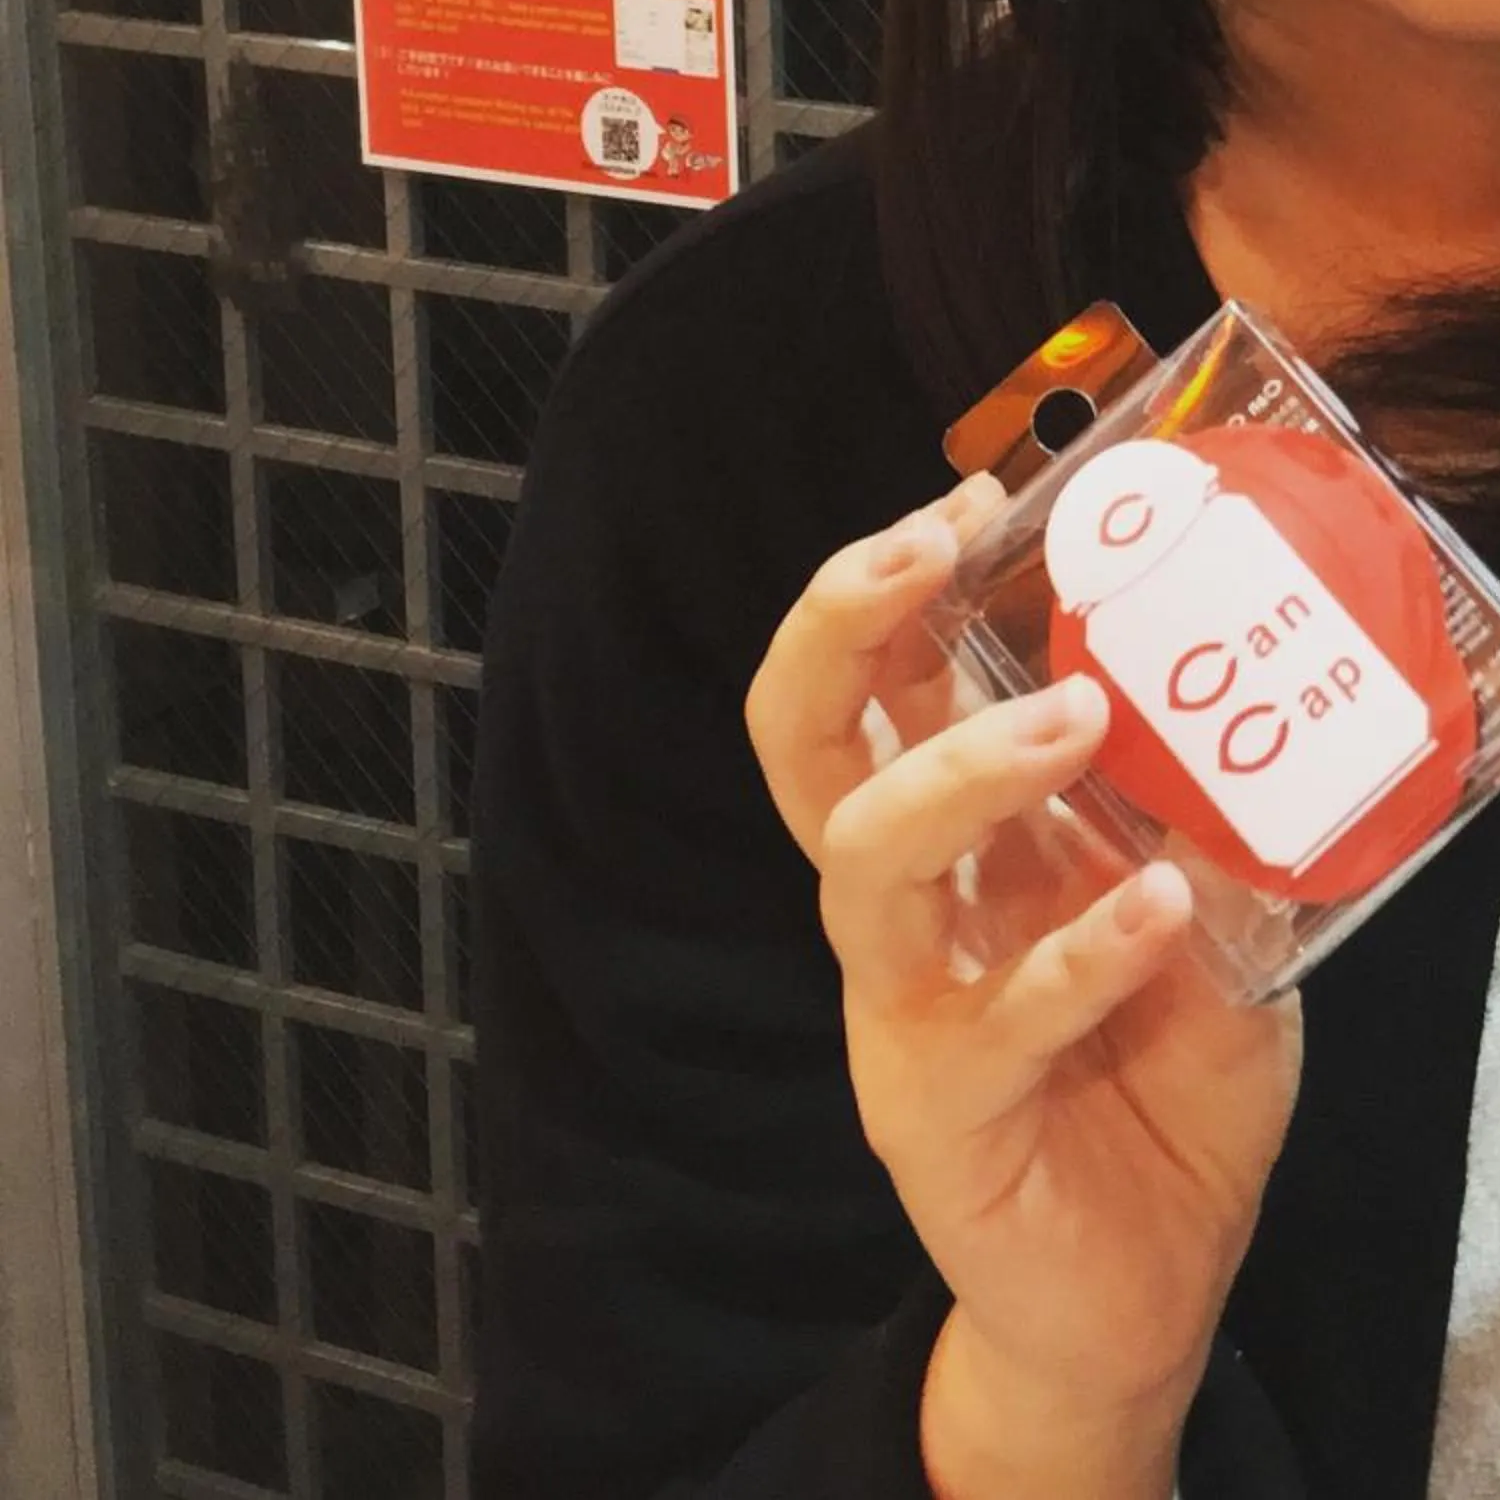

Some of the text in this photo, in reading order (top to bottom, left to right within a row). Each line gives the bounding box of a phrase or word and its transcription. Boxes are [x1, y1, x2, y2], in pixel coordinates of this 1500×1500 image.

[1099, 492, 1154, 547] C
[1167, 593, 1312, 713] Can
[1218, 656, 1362, 774] Cap
